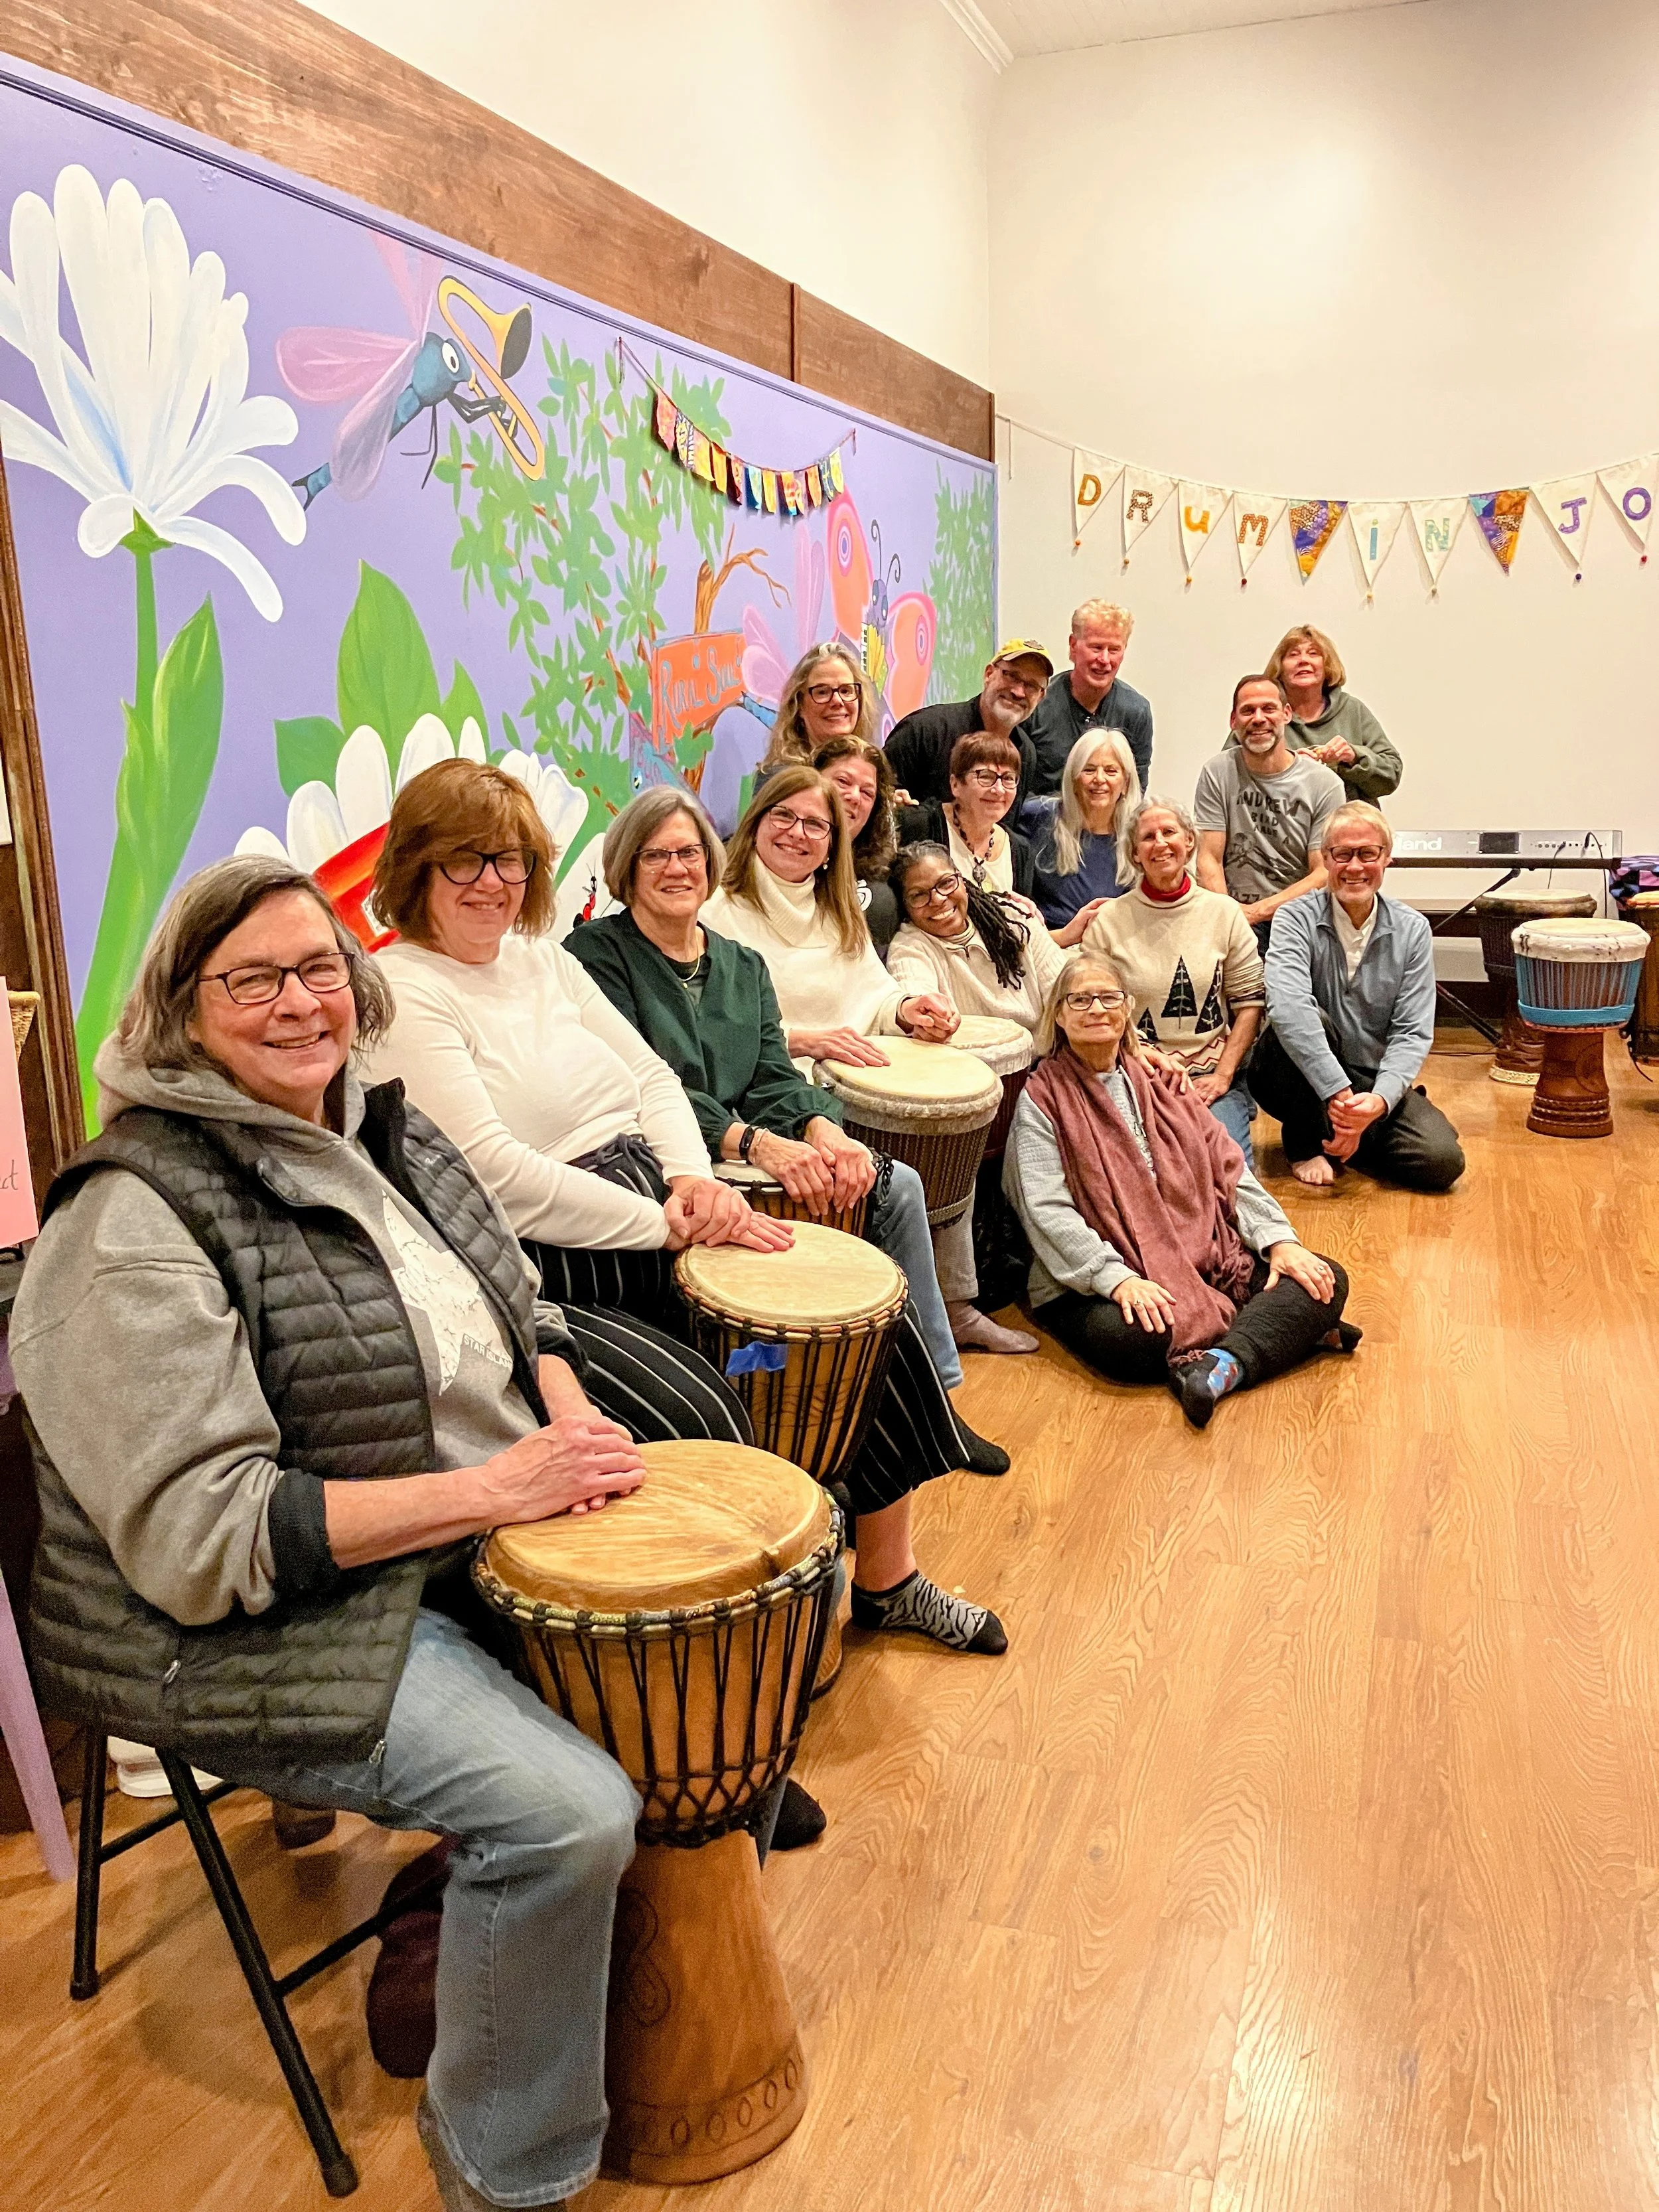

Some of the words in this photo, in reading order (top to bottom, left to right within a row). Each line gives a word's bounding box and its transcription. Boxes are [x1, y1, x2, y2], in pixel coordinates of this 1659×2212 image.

[1558, 486, 1652, 534] JO
[1236, 790, 1301, 817] ANDREW
[1396, 837, 1442, 850] land
[464, 1335, 486, 1357] STAR
